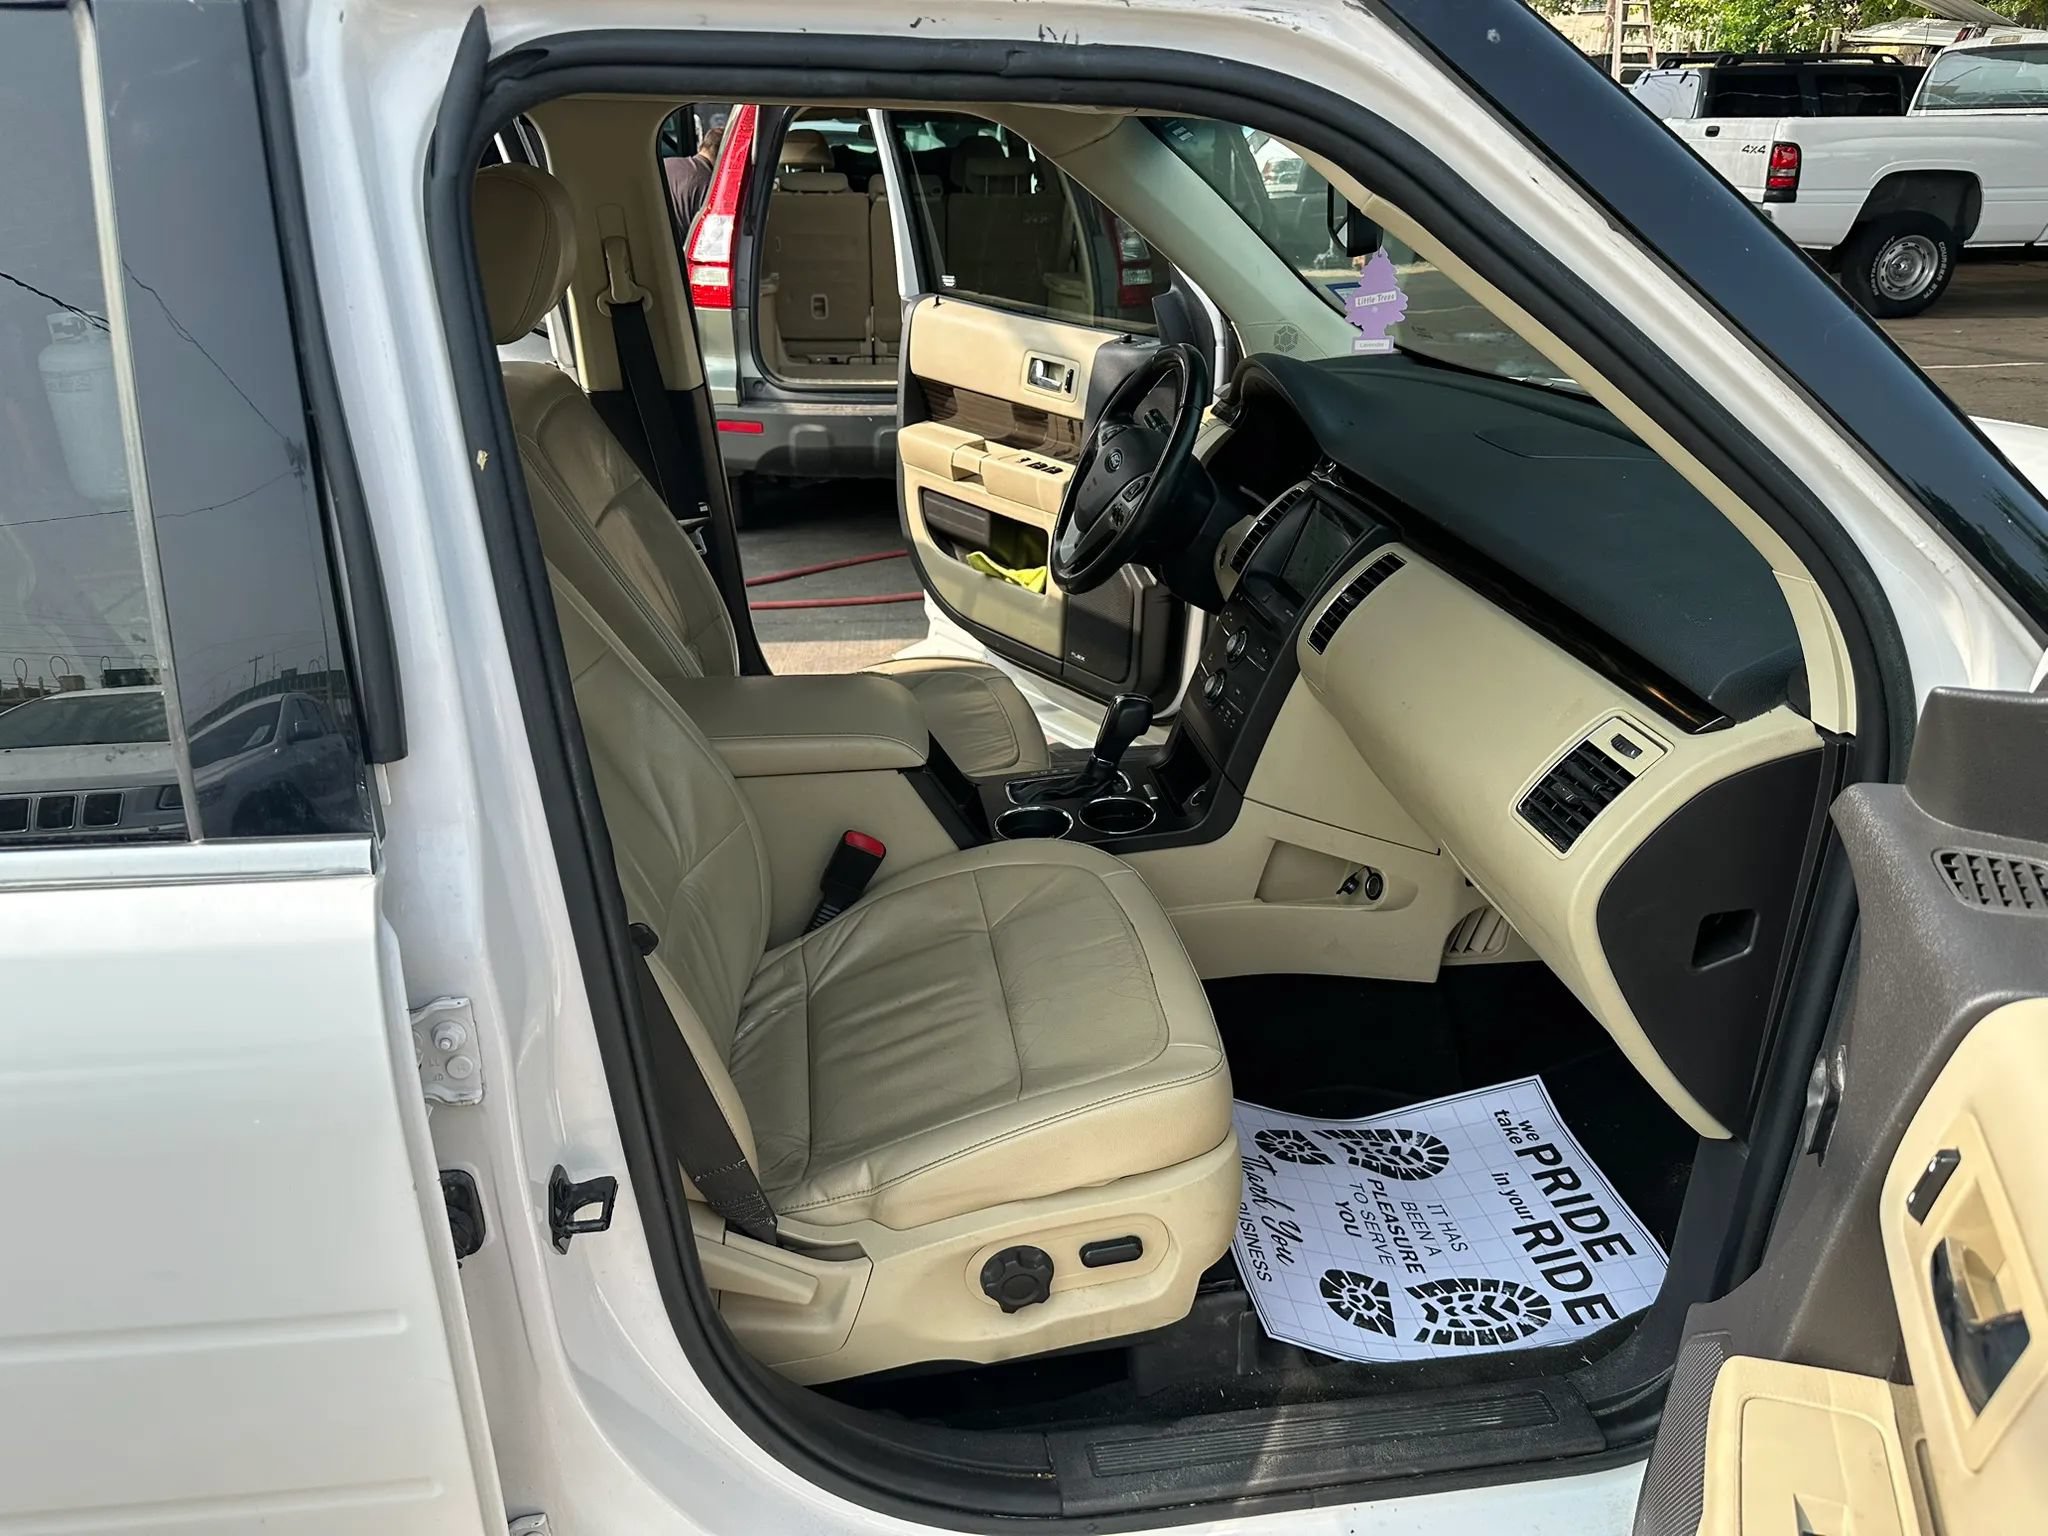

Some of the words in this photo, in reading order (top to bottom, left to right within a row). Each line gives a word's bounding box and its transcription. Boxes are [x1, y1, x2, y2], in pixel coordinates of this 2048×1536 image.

[1493, 1108, 1523, 1145] take
[1518, 1119, 1541, 1142] we
[1241, 1154, 1296, 1212] Thank
[1491, 1172, 1510, 1187] in
[1498, 1189, 1537, 1222] your
[1514, 1142, 1637, 1263] PRIDE
[1261, 1215, 1304, 1267] You
[1334, 1200, 1362, 1238] YOU
[1349, 1182, 1369, 1205] TO
[1360, 1209, 1397, 1266] SERVE
[1367, 1178, 1427, 1275] PLEASURE
[1400, 1201, 1436, 1241] BEEN
[1424, 1245, 1442, 1257] A
[1426, 1204, 1449, 1217] IT
[1438, 1222, 1469, 1252] HAS
[1511, 1219, 1621, 1326] RIDE
